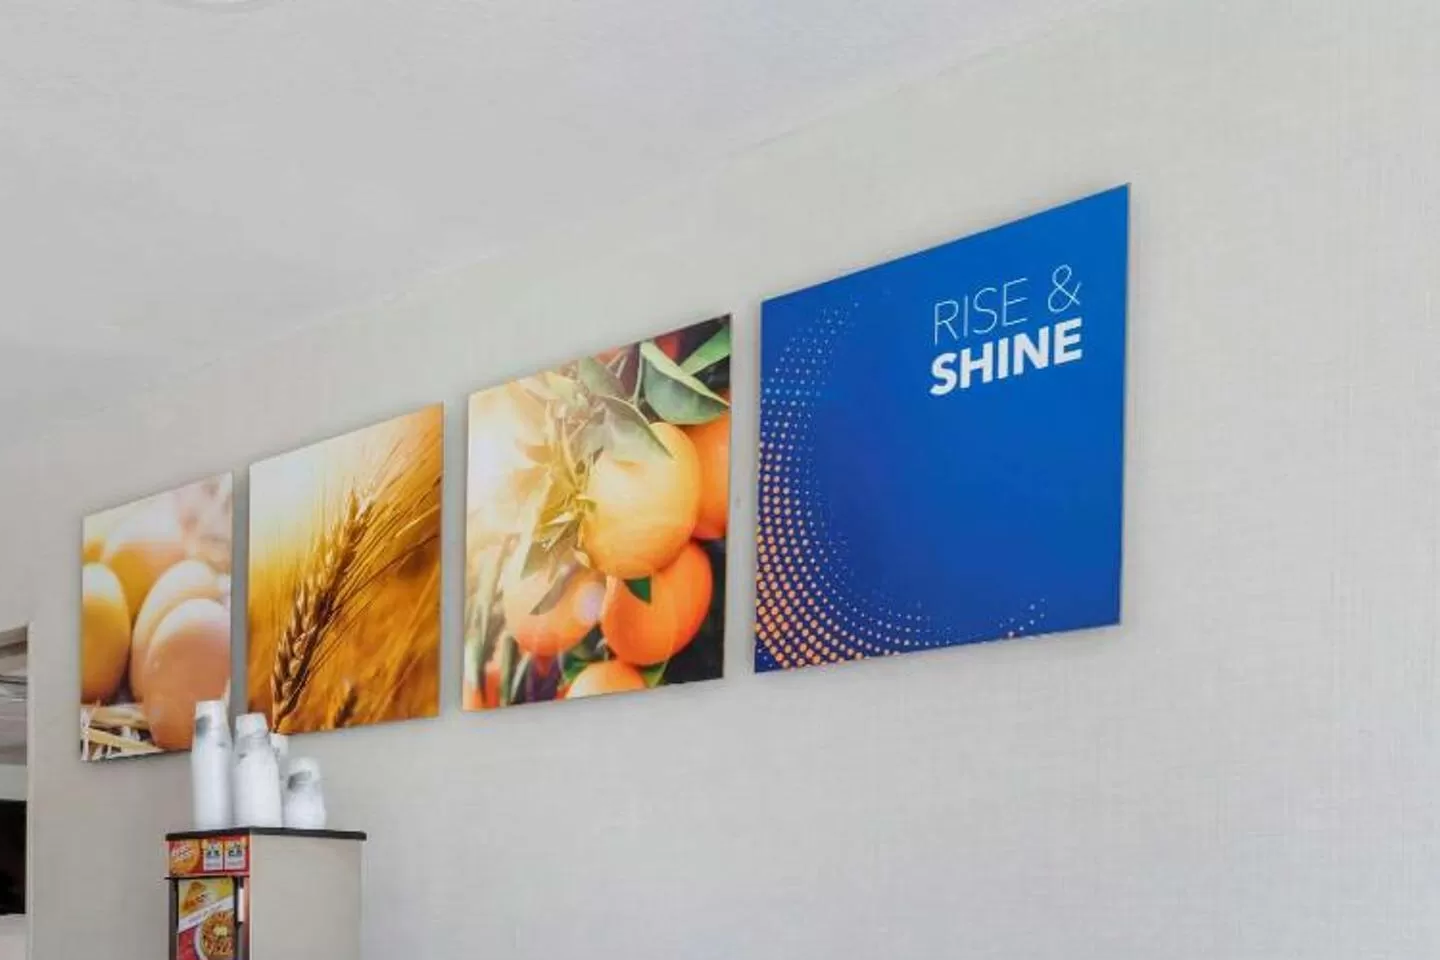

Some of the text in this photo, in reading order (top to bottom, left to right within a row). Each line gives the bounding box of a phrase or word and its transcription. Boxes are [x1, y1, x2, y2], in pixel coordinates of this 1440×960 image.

[934, 263, 1083, 346] RISE &
[929, 316, 1084, 396] SHINE
